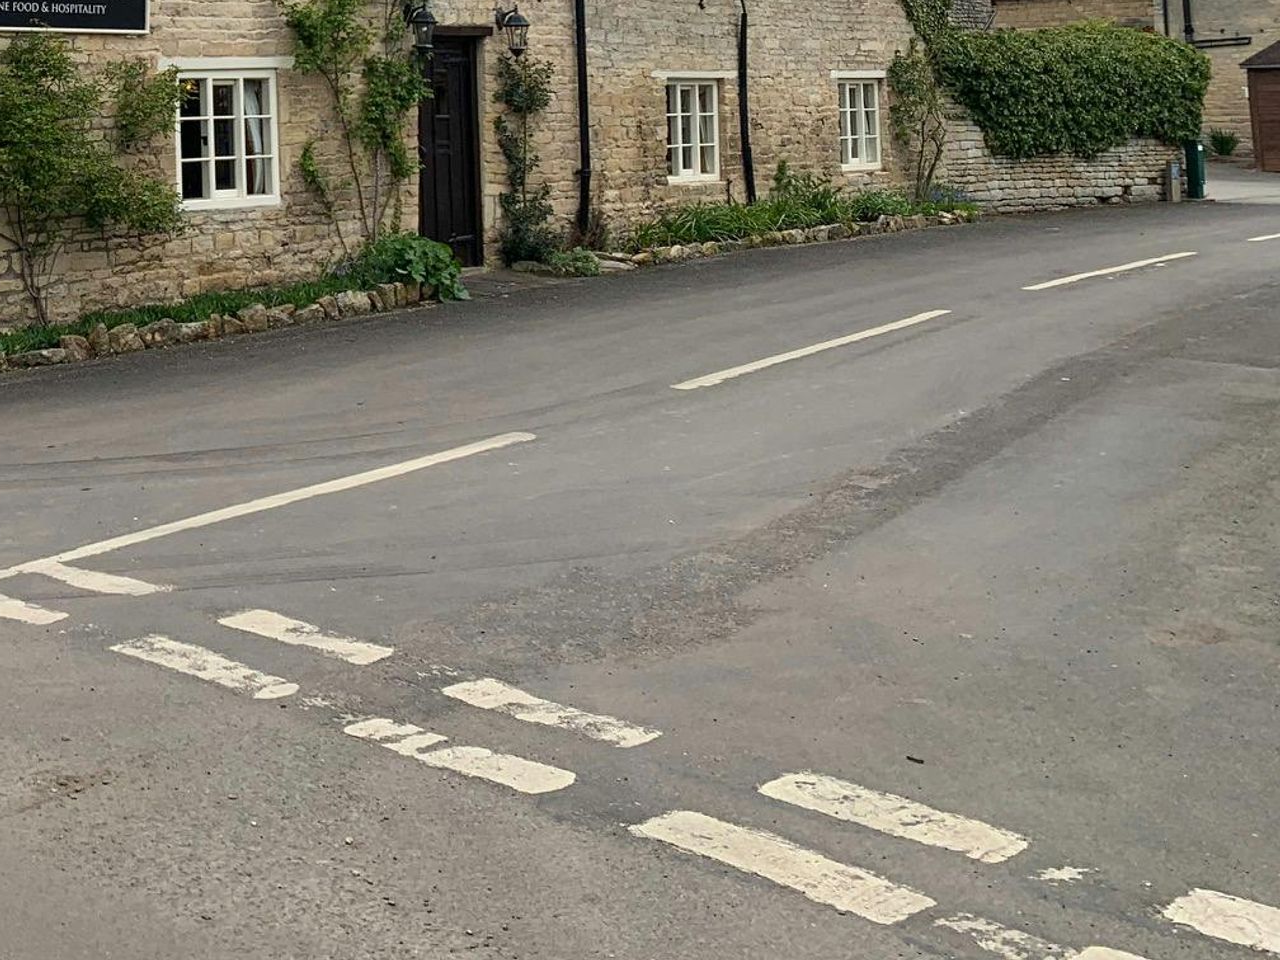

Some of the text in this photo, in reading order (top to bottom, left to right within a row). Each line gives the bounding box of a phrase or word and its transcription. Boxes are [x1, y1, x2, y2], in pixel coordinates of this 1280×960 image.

[12, 1, 39, 13] FOOD
[41, 2, 49, 13] &
[51, 3, 107, 15] HOSPITALITY
